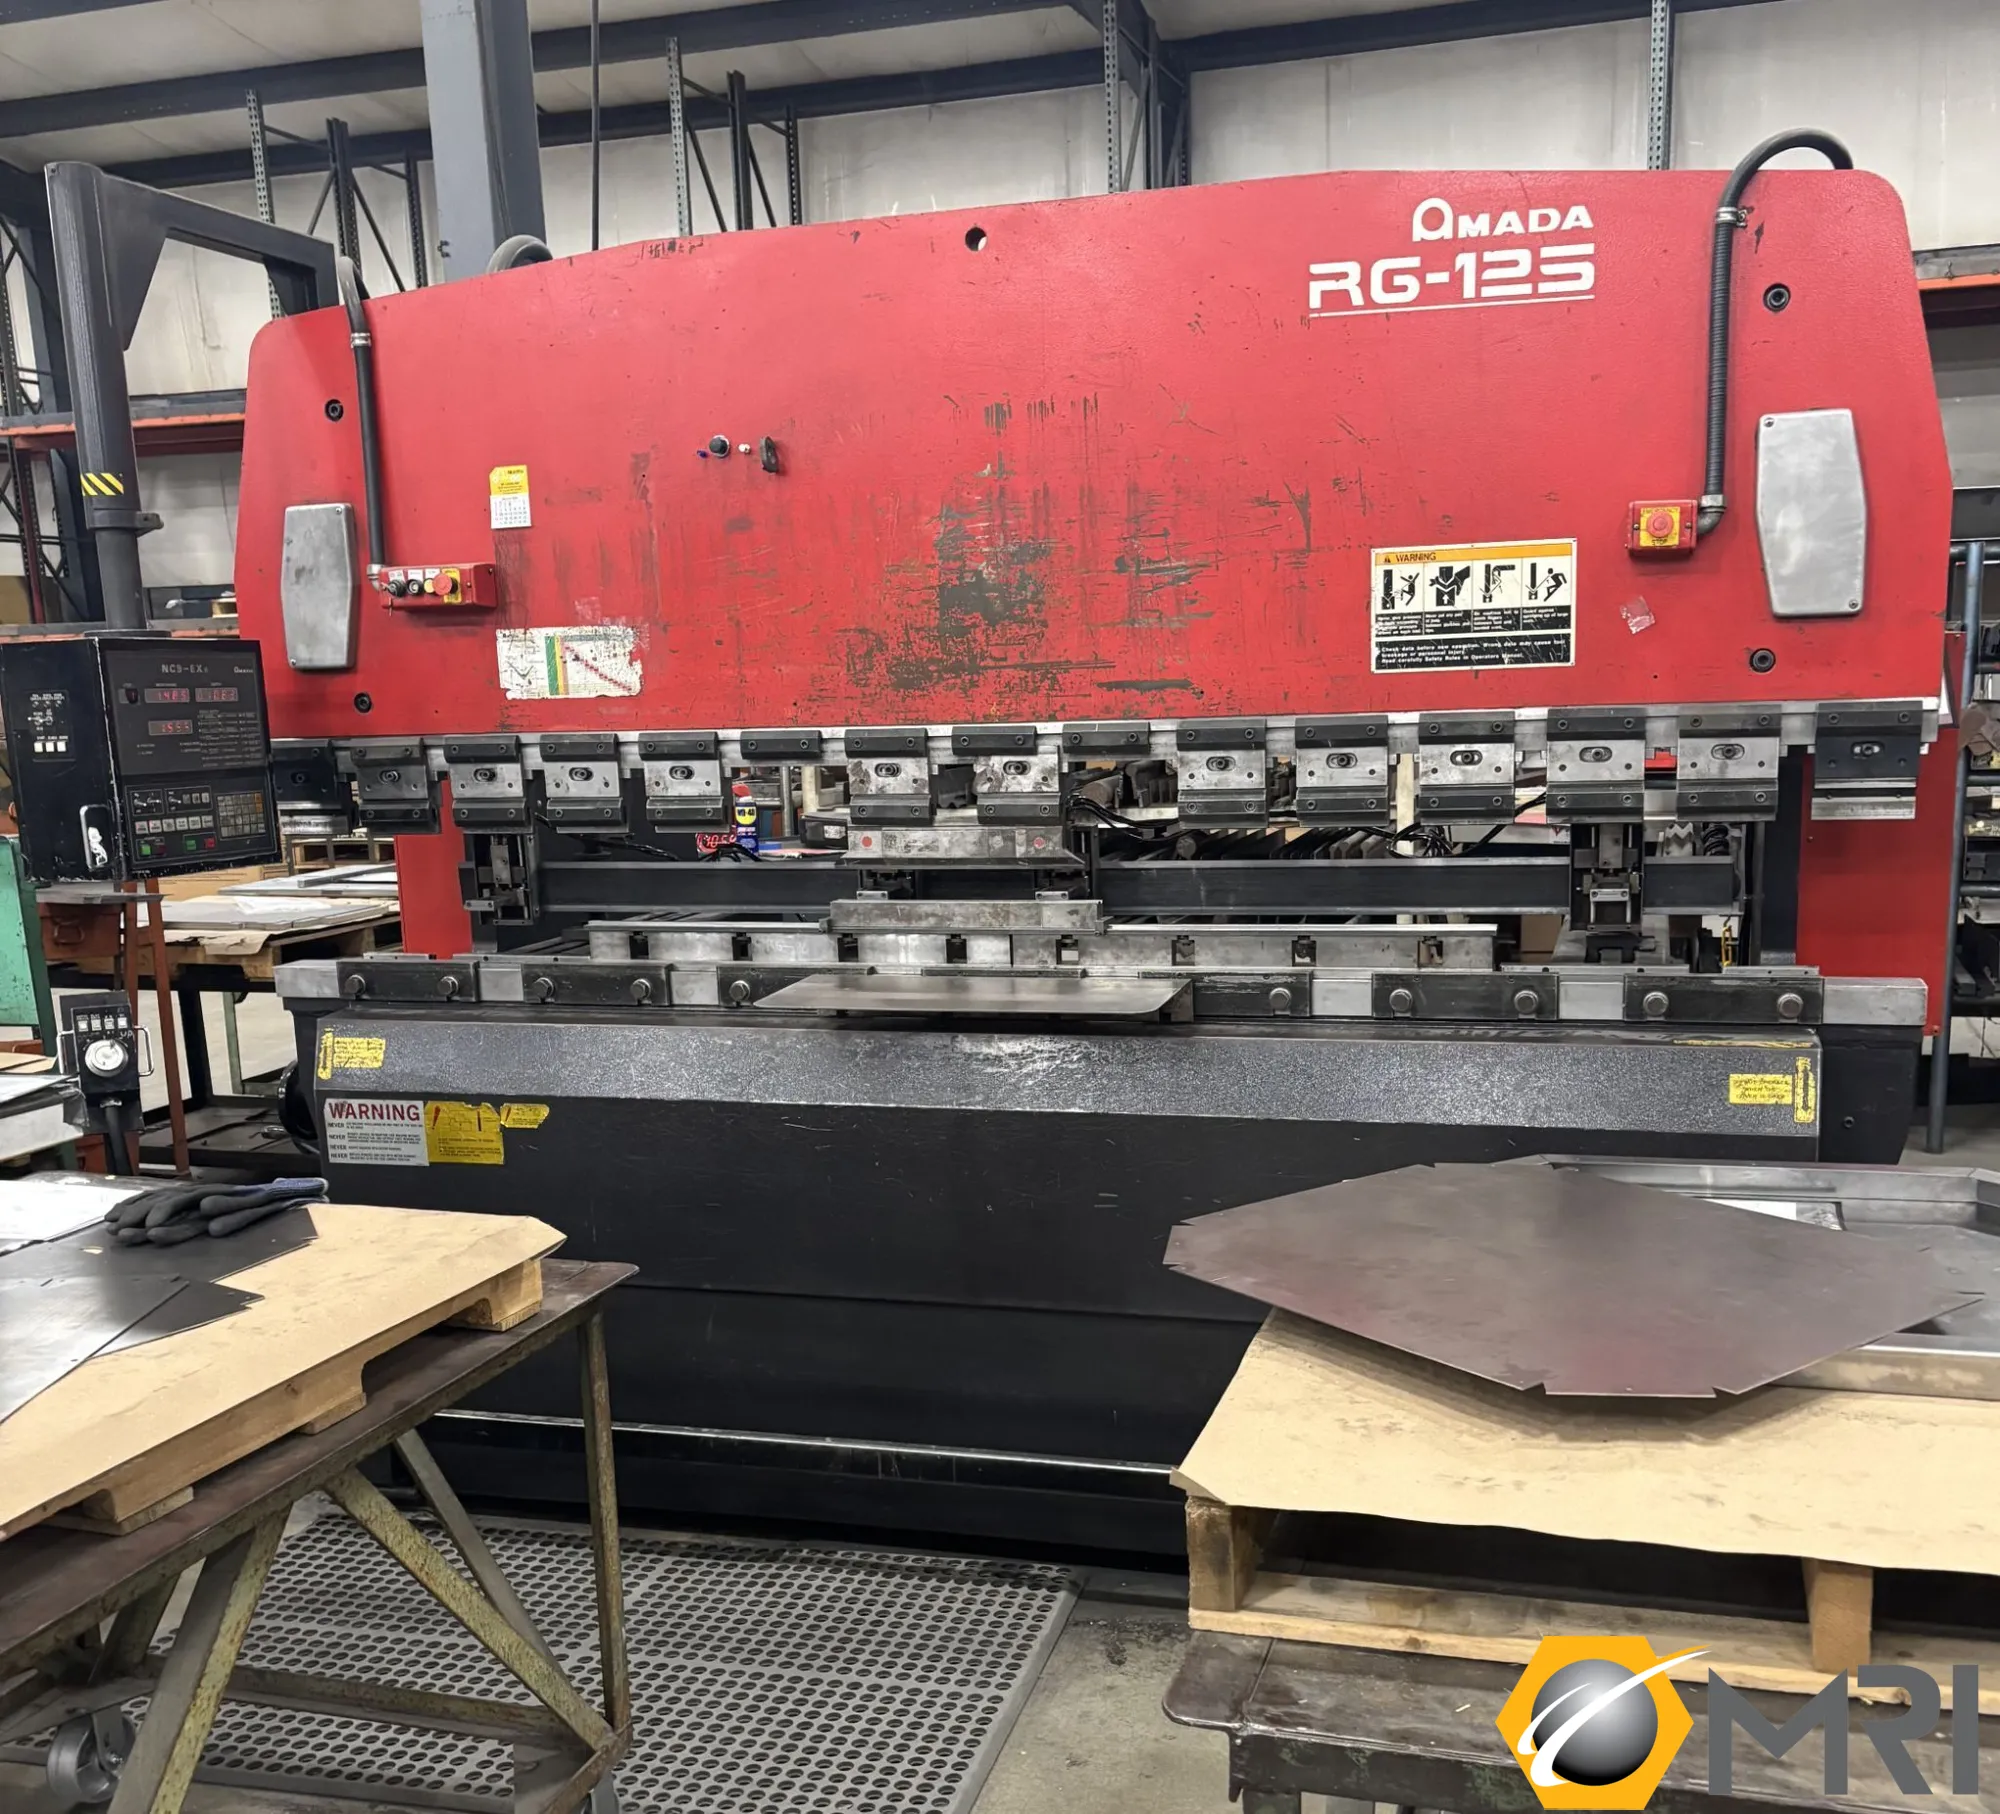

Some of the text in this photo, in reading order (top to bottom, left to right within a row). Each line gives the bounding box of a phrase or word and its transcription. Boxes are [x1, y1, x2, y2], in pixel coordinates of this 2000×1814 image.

[1412, 197, 1594, 242] AMADA
[1308, 243, 1596, 309] RG-125
[1396, 552, 1437, 562] WARNING
[328, 1101, 420, 1121] WARNING
